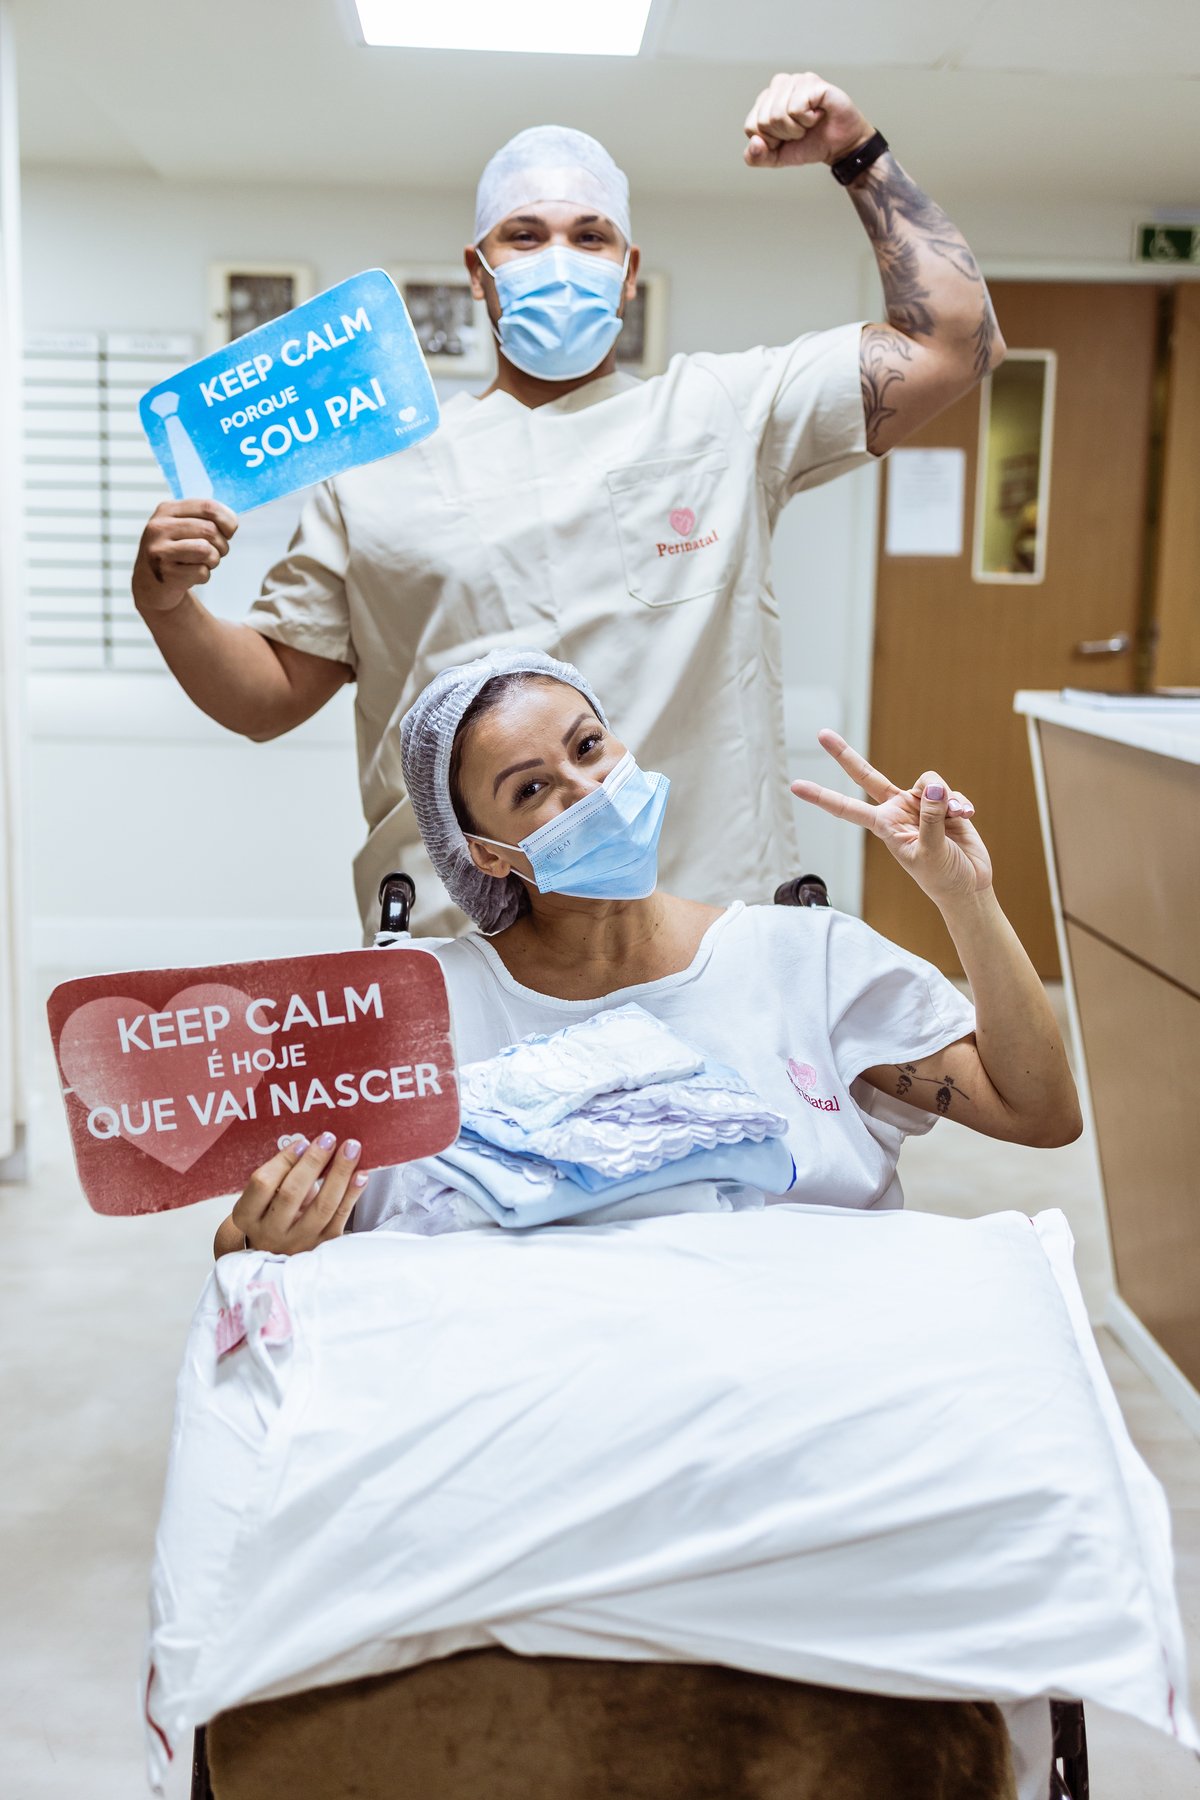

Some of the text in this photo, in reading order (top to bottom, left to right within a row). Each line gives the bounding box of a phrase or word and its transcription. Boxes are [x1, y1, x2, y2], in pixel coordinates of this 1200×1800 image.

[199, 306, 373, 407] KEEP CALM
[220, 385, 299, 434] PORQUE
[239, 377, 387, 468] SOU PAI
[656, 529, 719, 557] Perinatal
[117, 983, 384, 1054] KEEP CALM
[207, 1043, 307, 1078] É HOJE
[86, 1062, 443, 1140] QUE VAI NASCER
